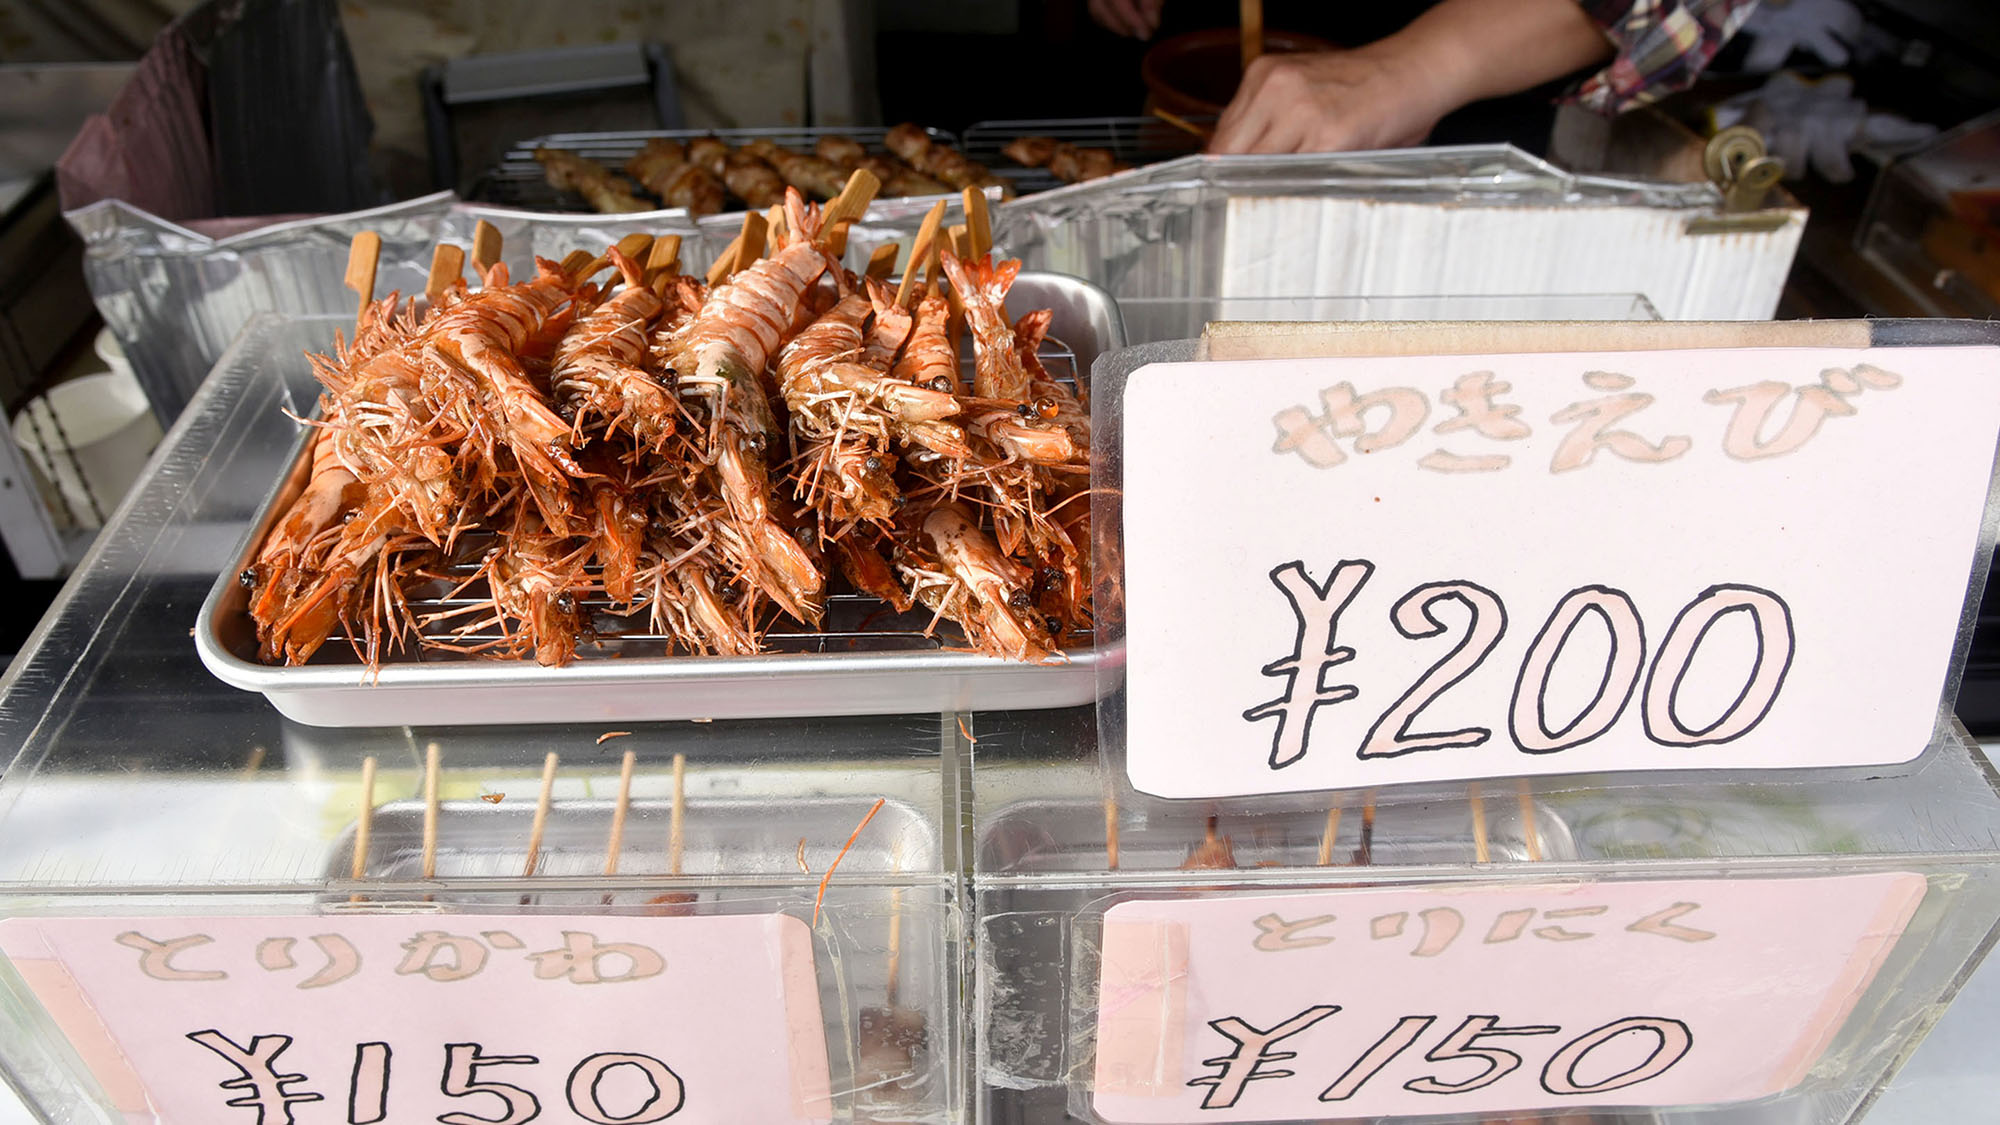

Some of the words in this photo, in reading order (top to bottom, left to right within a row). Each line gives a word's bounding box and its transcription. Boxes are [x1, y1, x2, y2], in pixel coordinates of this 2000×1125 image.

[1271, 362, 1904, 475] やきえび
[1244, 559, 1797, 770] ¥200
[114, 930, 668, 989] とりかわ
[1251, 902, 1717, 958] とりにく
[1188, 1005, 1694, 1111] ¥150
